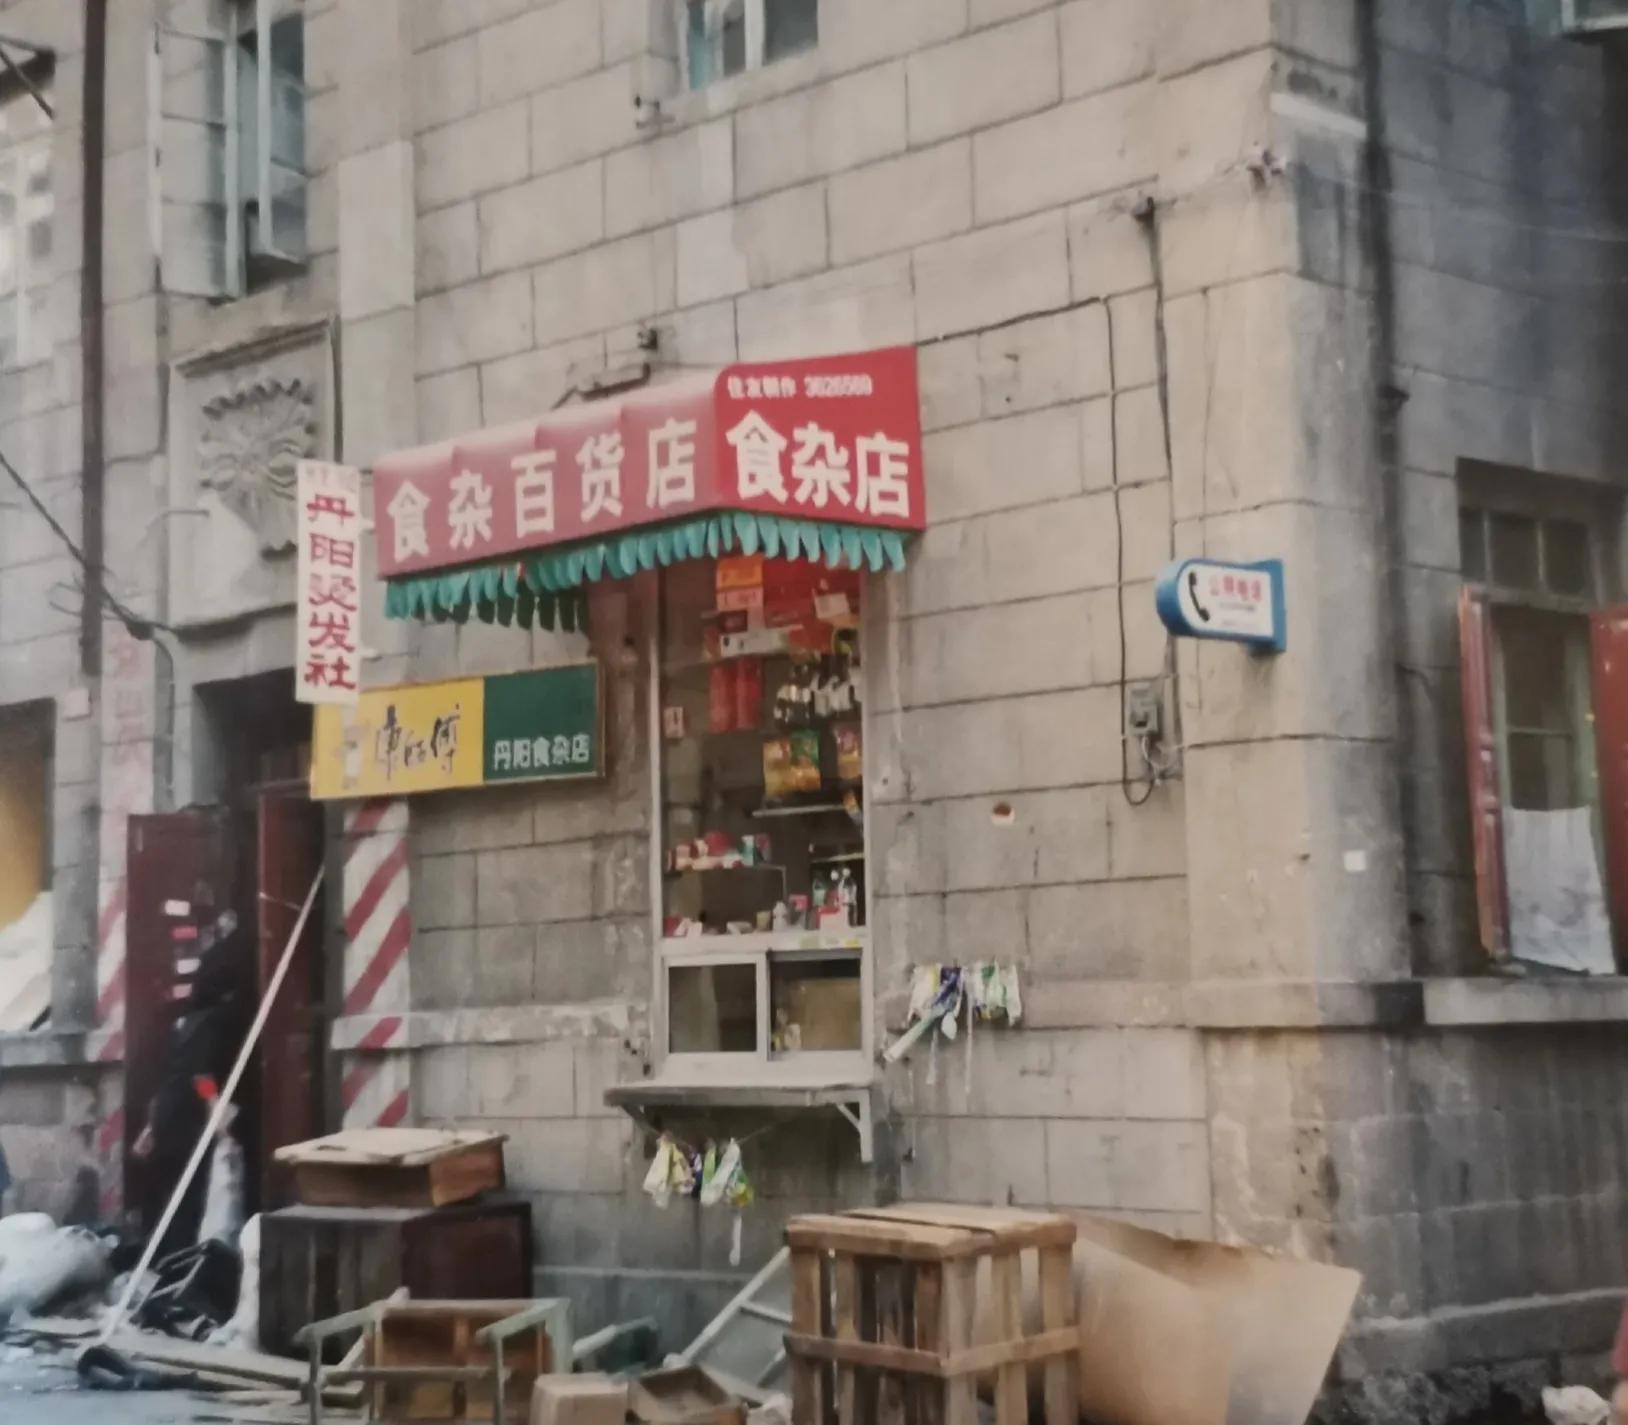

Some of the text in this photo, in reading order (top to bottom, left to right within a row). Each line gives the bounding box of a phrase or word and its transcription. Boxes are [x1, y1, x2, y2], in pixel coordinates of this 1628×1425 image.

[386, 418, 697, 563] 食杂百货店
[726, 410, 911, 520] 食杂店
[492, 734, 591, 771] 丹阳食杂店
